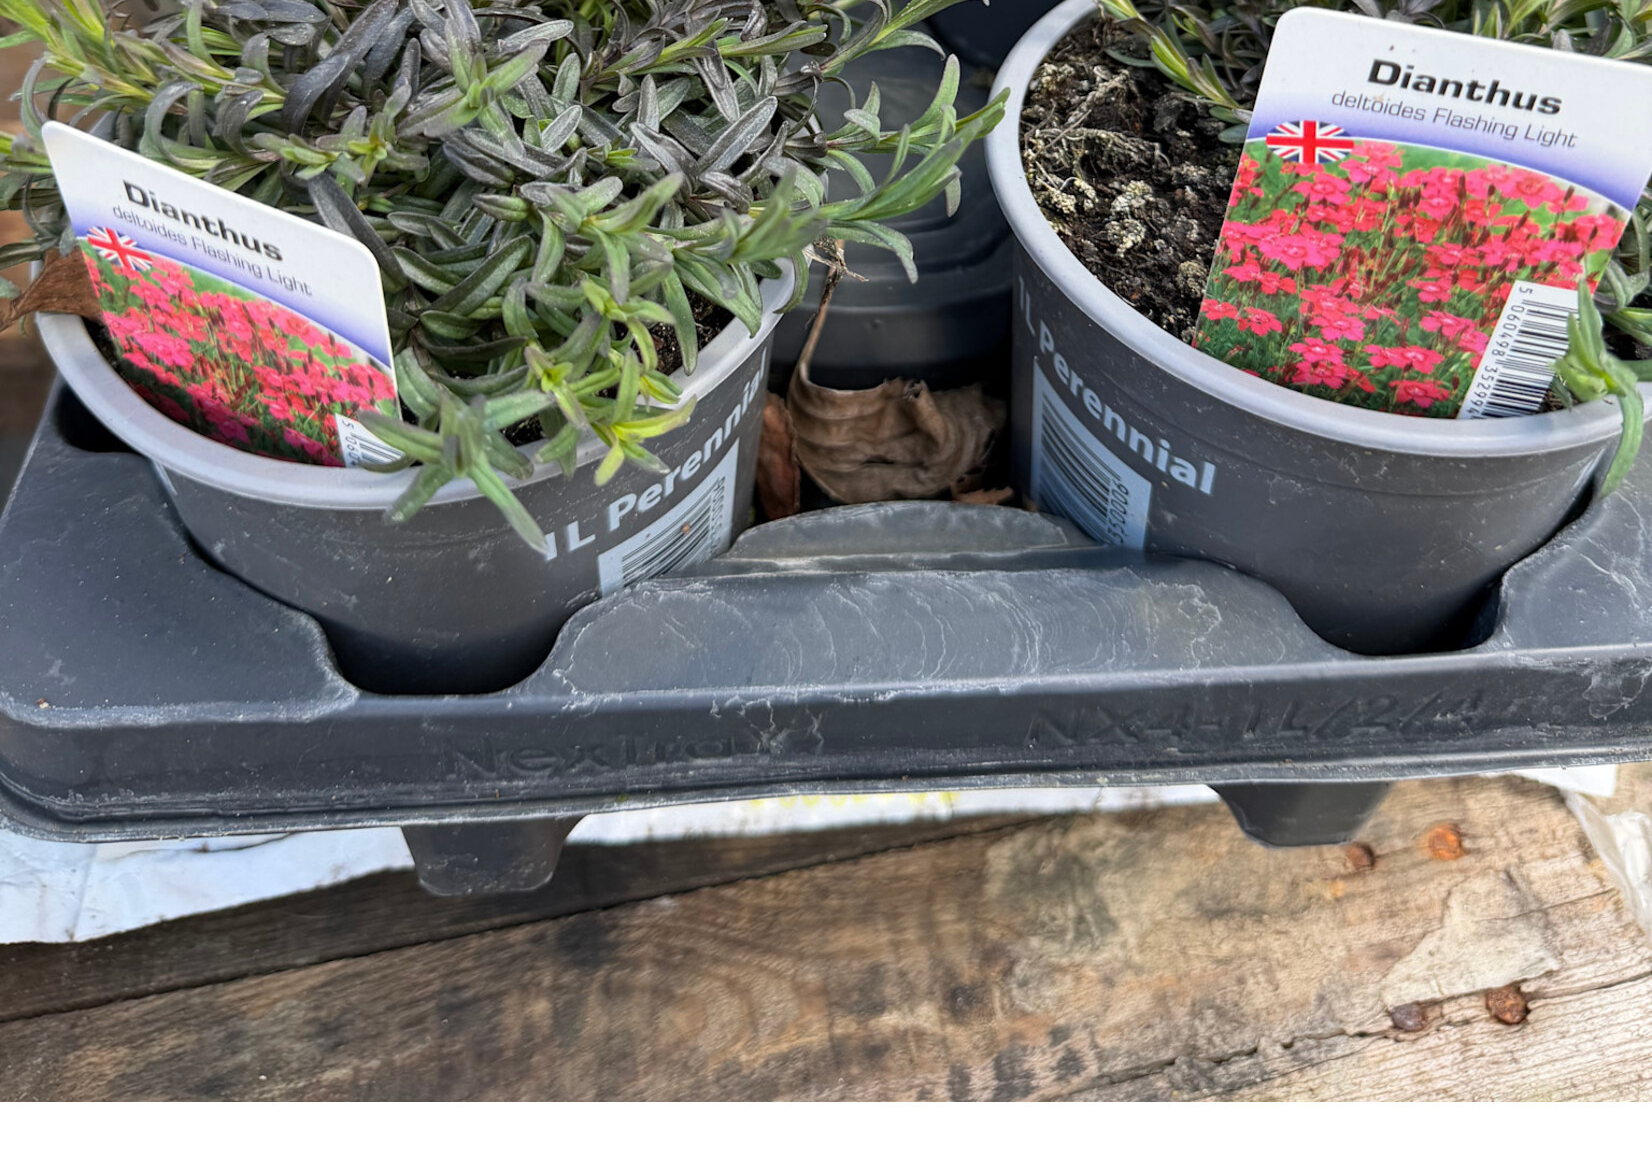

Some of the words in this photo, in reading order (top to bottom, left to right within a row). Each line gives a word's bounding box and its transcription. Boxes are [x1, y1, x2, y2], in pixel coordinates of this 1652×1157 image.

[1331, 90, 1427, 122] deltoides
[1432, 106, 1518, 142] Flashing
[1523, 123, 1579, 149] Light
[1367, 58, 1563, 116] Dianthus
[112, 205, 188, 246] deltoides
[191, 238, 263, 279] Flashing
[266, 267, 313, 296] Light
[122, 179, 284, 262] Dianthus
[1491, 303, 1526, 358] 060498
[608, 346, 769, 533] Perennial
[1039, 319, 1217, 496] Perennial
